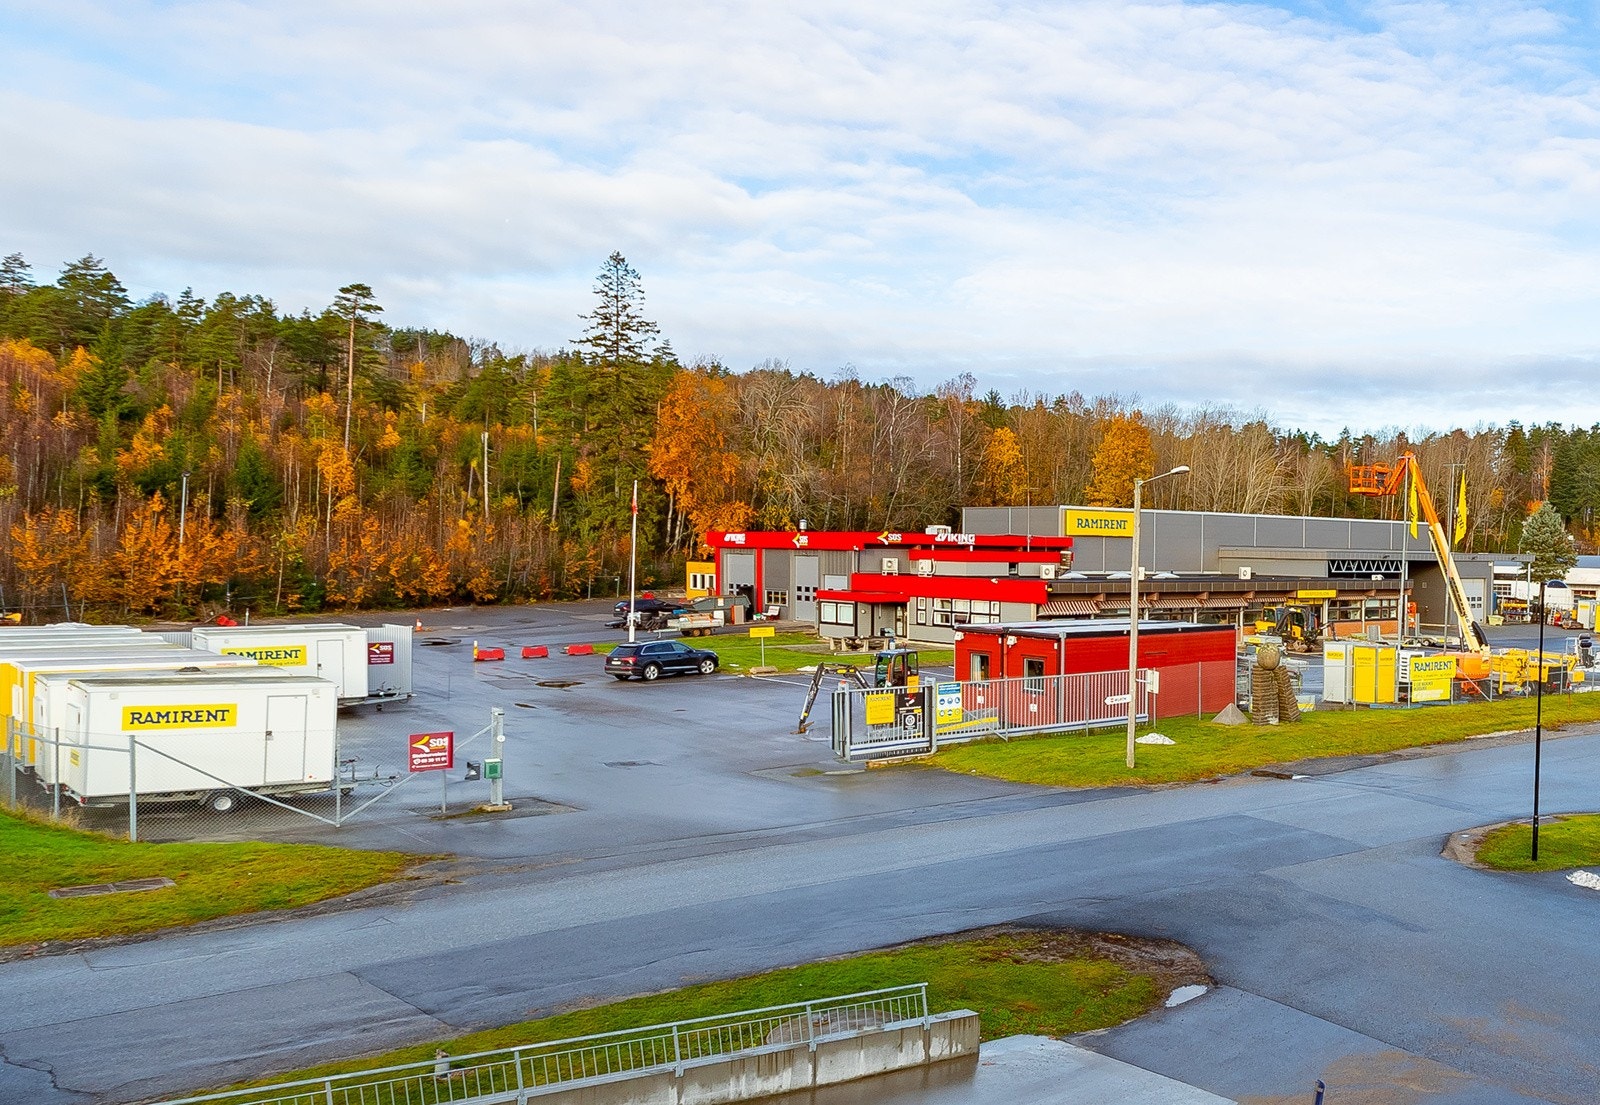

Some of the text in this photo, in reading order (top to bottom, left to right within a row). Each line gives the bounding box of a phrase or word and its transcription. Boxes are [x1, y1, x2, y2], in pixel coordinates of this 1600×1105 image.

[1076, 518, 1128, 529] RAMIRENT
[938, 533, 975, 542] VIKING
[1413, 660, 1453, 672] RAMIRENT
[129, 709, 230, 725] RAMIRENT
